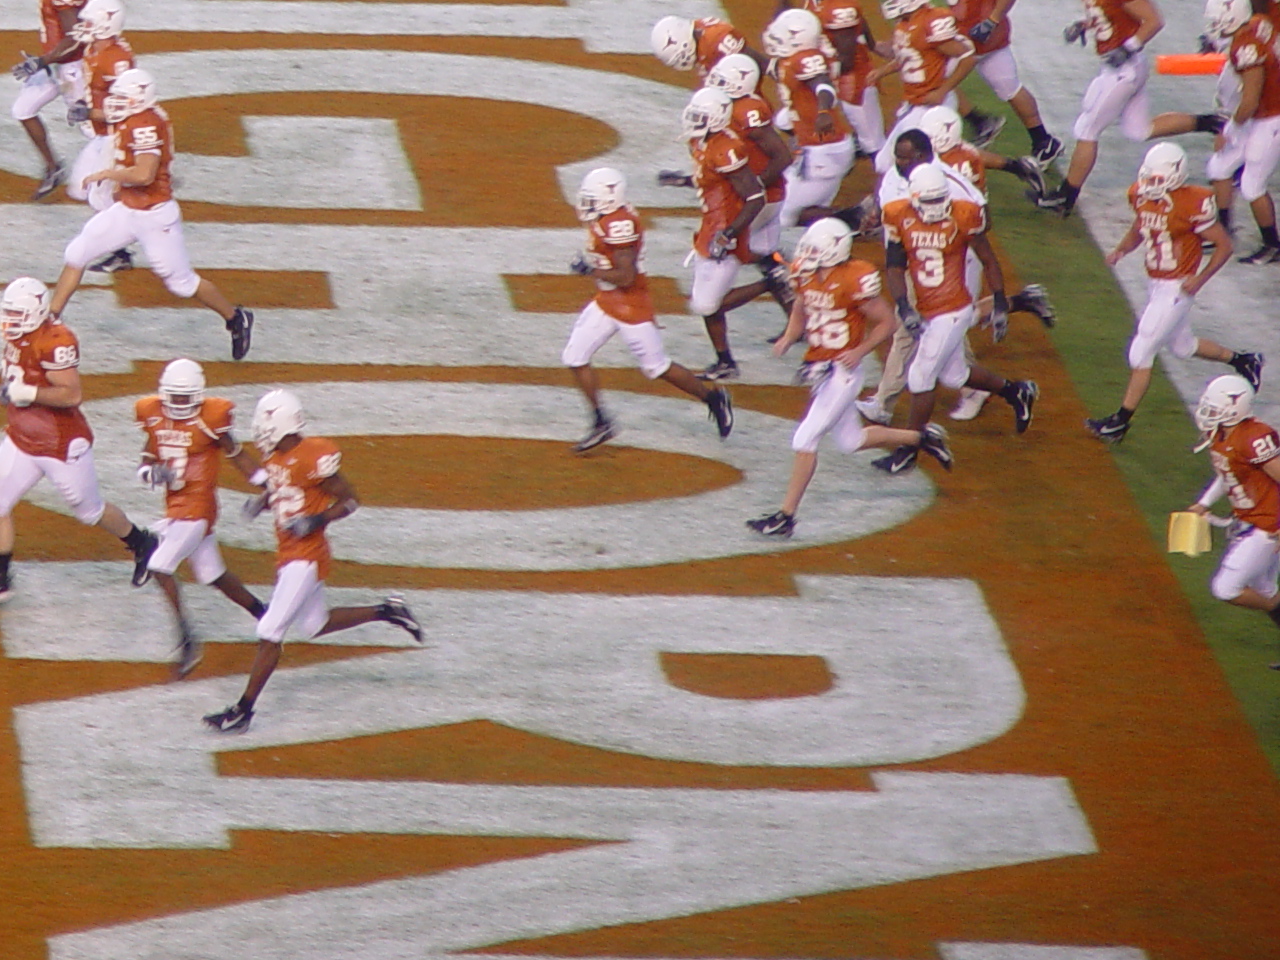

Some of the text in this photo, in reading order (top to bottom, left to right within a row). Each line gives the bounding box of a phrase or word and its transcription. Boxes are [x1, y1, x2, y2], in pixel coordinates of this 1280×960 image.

[746, 110, 760, 127] 2
[132, 126, 158, 145] 55
[727, 148, 739, 165] 1
[910, 230, 946, 248] TEXAS
[915, 247, 944, 287] 3
[1252, 434, 1277, 457] 21
